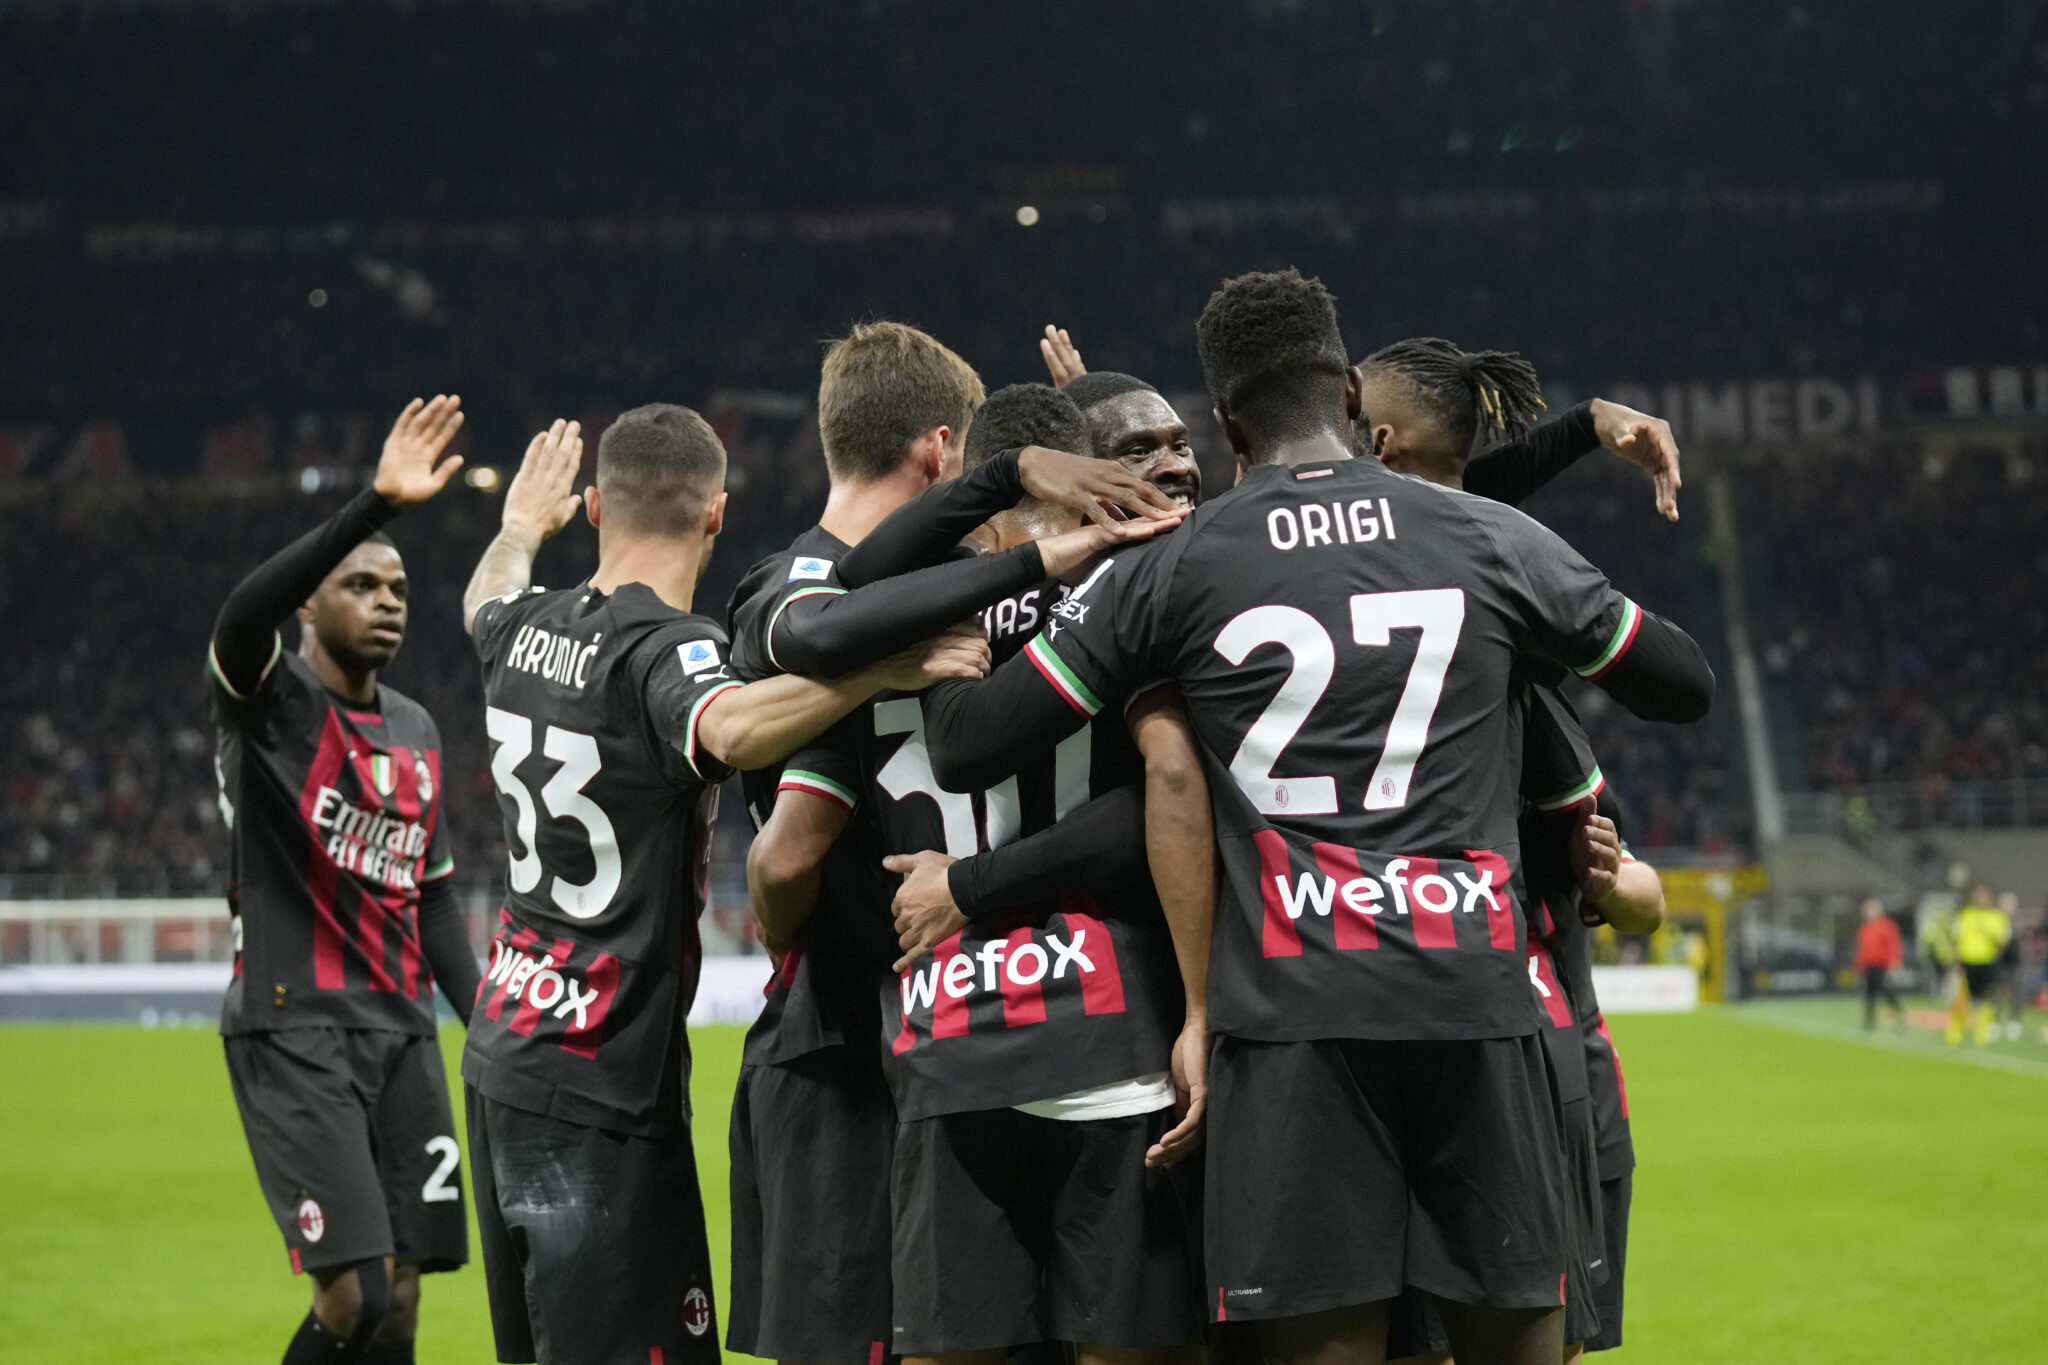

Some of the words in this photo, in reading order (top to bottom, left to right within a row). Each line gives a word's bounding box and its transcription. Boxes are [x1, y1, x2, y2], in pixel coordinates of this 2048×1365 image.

[1267, 497, 1396, 550] ORIGI
[506, 624, 603, 689] KRUNIĆ
[1213, 587, 1465, 815] 27
[486, 705, 622, 919] 33
[1275, 859, 1501, 920] wefox
[902, 929, 1096, 1016] wefox
